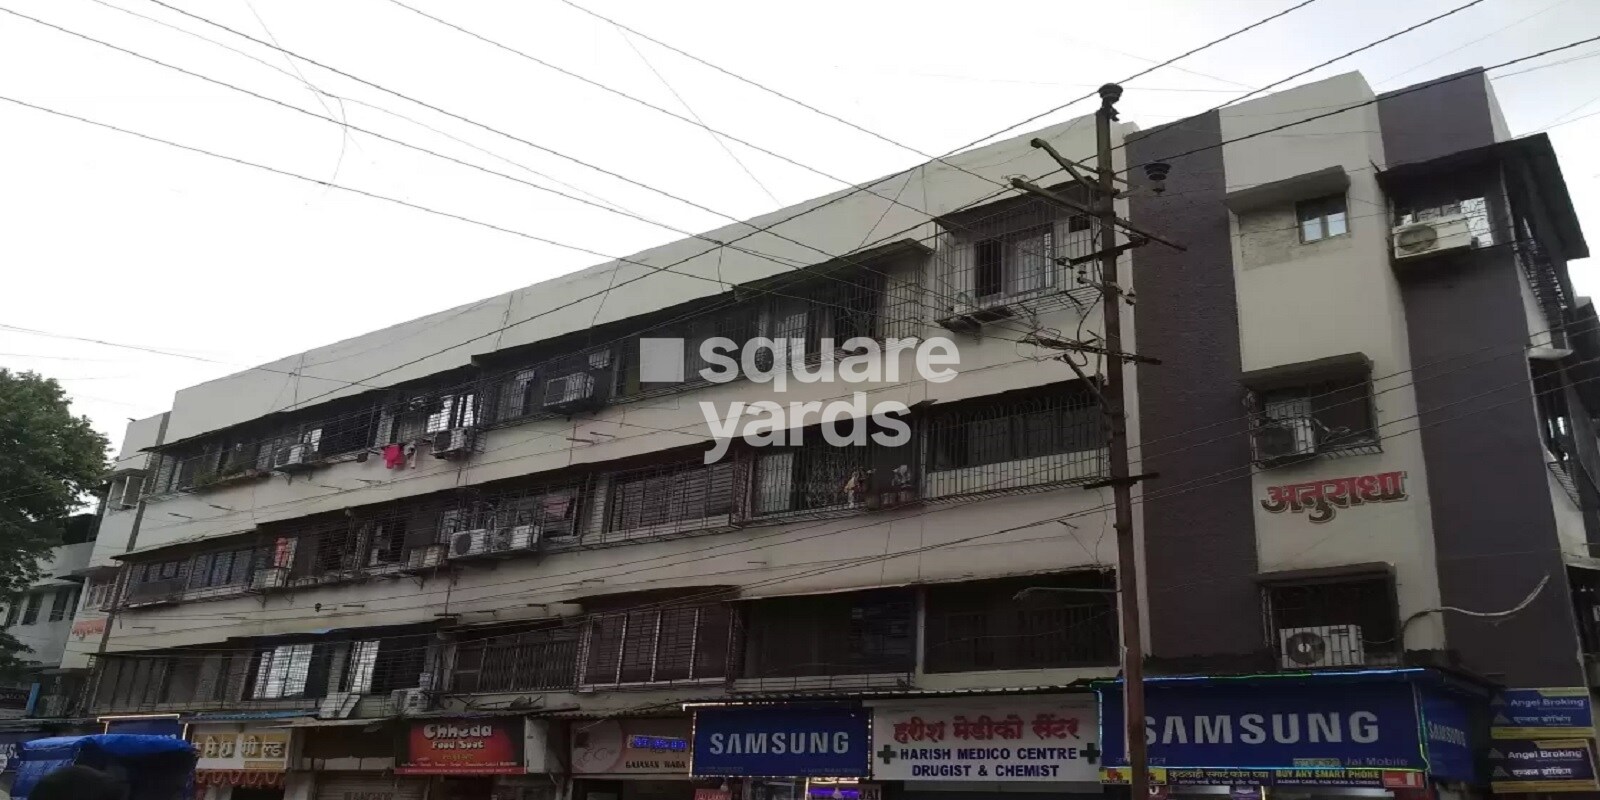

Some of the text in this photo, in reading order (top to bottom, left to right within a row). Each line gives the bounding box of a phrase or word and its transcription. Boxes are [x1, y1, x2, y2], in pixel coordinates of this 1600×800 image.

[1261, 470, 1408, 522] अनुराधा
[1511, 699, 1541, 708] Angel
[1543, 698, 1584, 707] Broking
[423, 724, 493, 739] Chheda
[894, 716, 945, 743] हरीश
[432, 740, 485, 750] Food Spot
[709, 731, 850, 755] SAMSUNG
[900, 747, 1077, 760] HARISH MEDICO CENTRE
[1508, 751, 1538, 760] Angel
[1540, 750, 1582, 758] Broking
[1366, 757, 1409, 766] Mobile
[912, 764, 1060, 777] DRUGIST & CHEMIST
[1276, 770, 1292, 778] BUY
[1315, 770, 1345, 778] SMART
